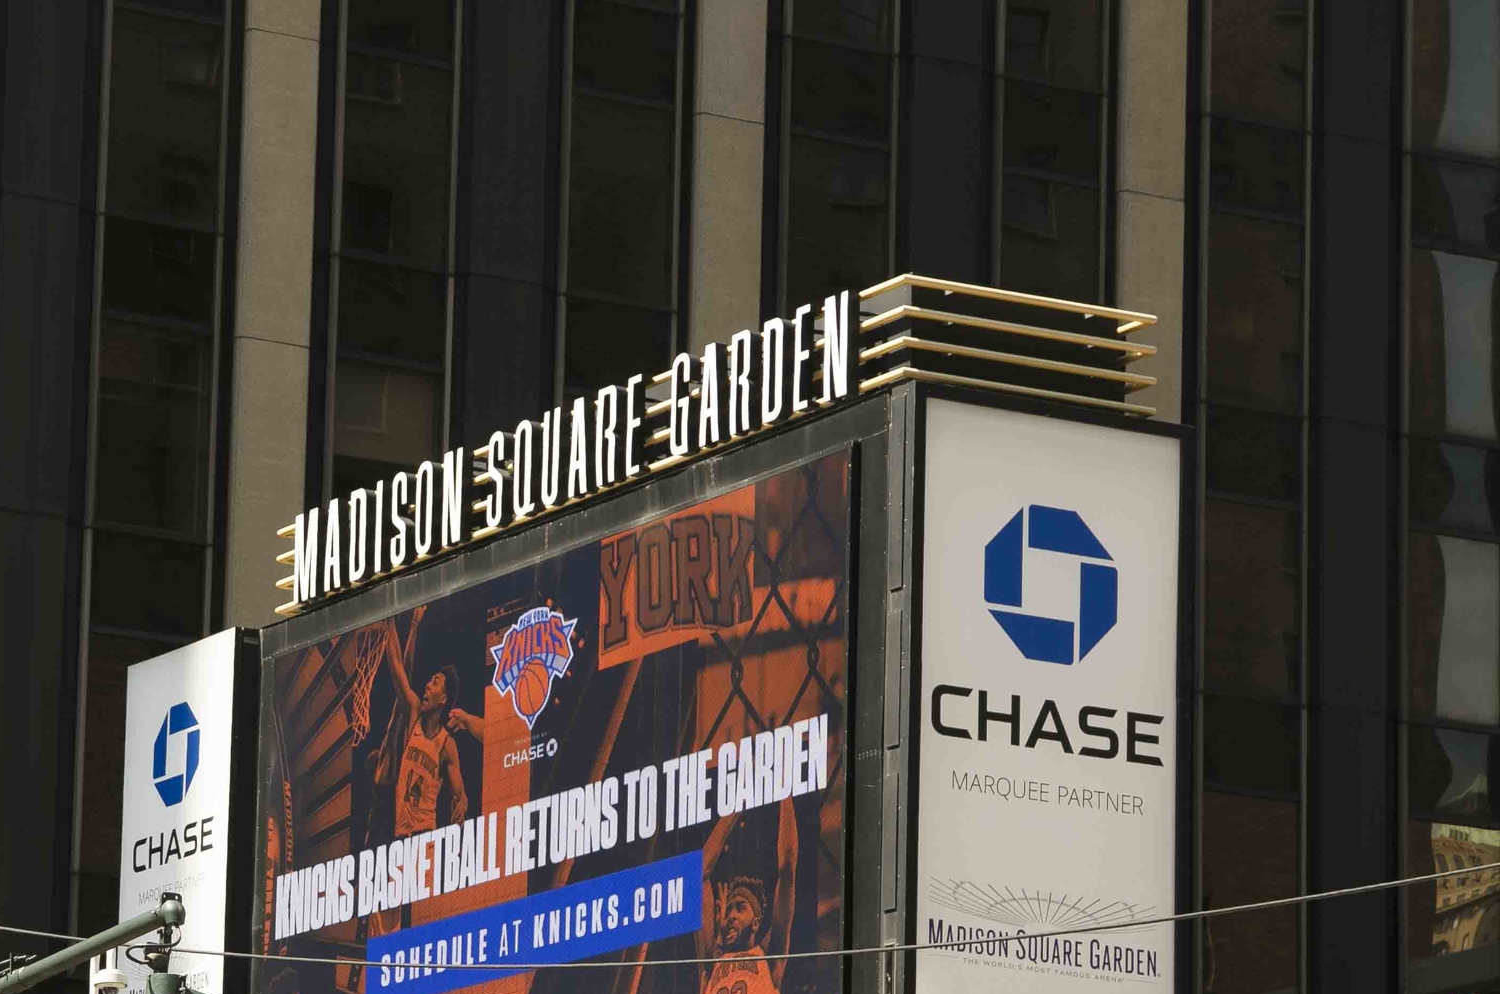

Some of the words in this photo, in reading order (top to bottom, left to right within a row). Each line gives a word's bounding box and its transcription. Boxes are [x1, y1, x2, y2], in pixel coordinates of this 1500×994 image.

[293, 447, 464, 604] MADISON
[487, 374, 642, 528] SQUARE
[669, 290, 850, 456] GARDEN
[600, 514, 758, 650] YORK
[496, 616, 570, 681] KNICKS
[504, 743, 545, 768] CHASE
[930, 683, 1165, 768] CHASE
[951, 770, 1050, 803] MARQUEE
[1058, 785, 1144, 816] PARTNER
[132, 816, 214, 873] CHASE
[274, 855, 355, 940] KNICKS
[357, 811, 500, 917] BASKETBALL
[505, 776, 619, 876] RETURNS
[623, 765, 658, 843] TO
[663, 748, 712, 832] THE
[717, 713, 828, 817] GARDEN
[381, 928, 488, 987] SCHEDULE
[499, 919, 523, 957] AT
[533, 877, 683, 949] KNICKS.COM
[928, 918, 1008, 958] MADISON
[1016, 929, 1083, 968] SQUARE
[1090, 939, 1157, 978] GARDEN
[962, 957, 979, 965] THE
